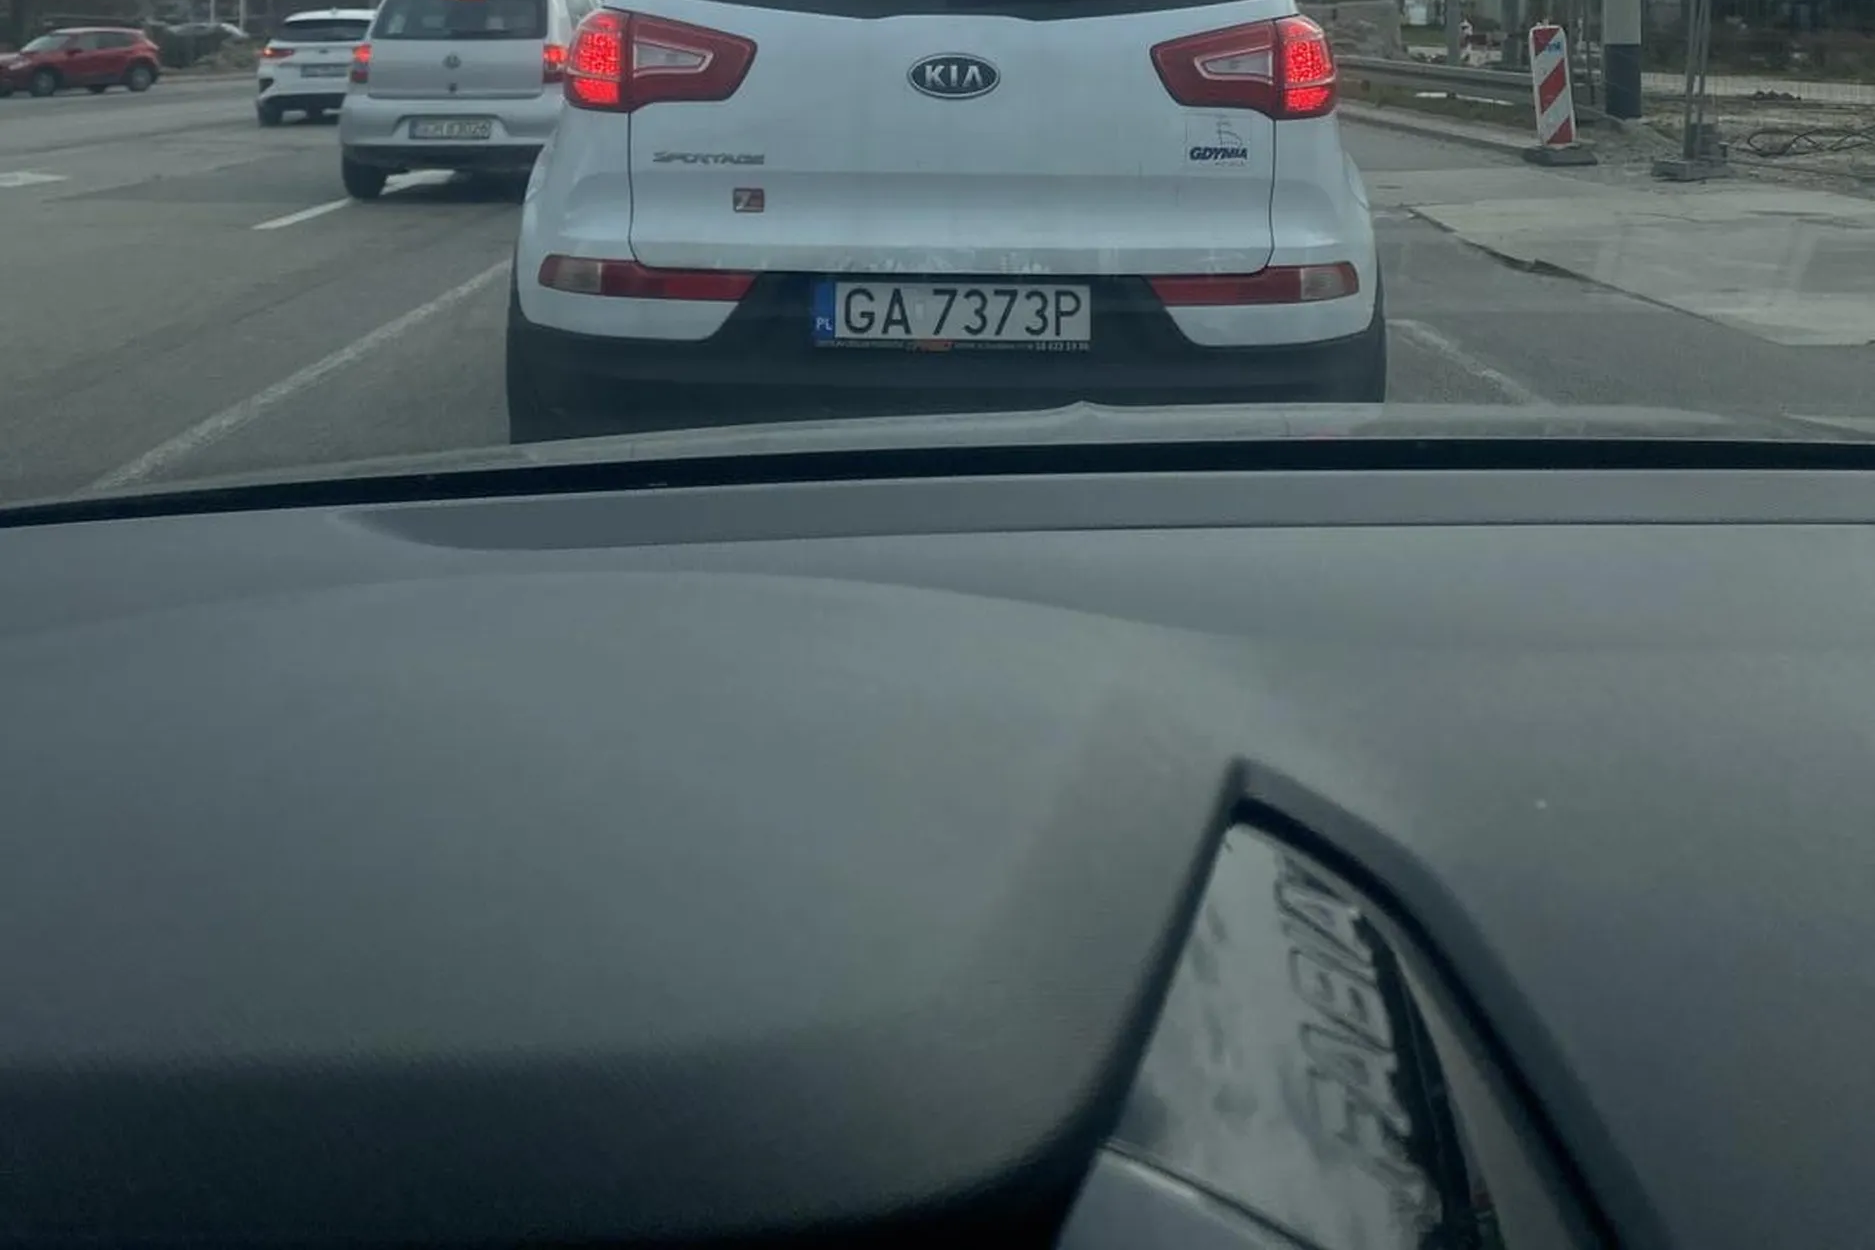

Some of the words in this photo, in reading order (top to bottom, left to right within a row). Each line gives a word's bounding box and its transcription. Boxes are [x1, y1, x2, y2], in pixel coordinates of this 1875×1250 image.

[924, 64, 983, 87] KIA
[1190, 147, 1248, 160] GDYNIA
[843, 287, 912, 335] GA
[932, 288, 1082, 336] 7373P
[815, 316, 833, 331] PL
